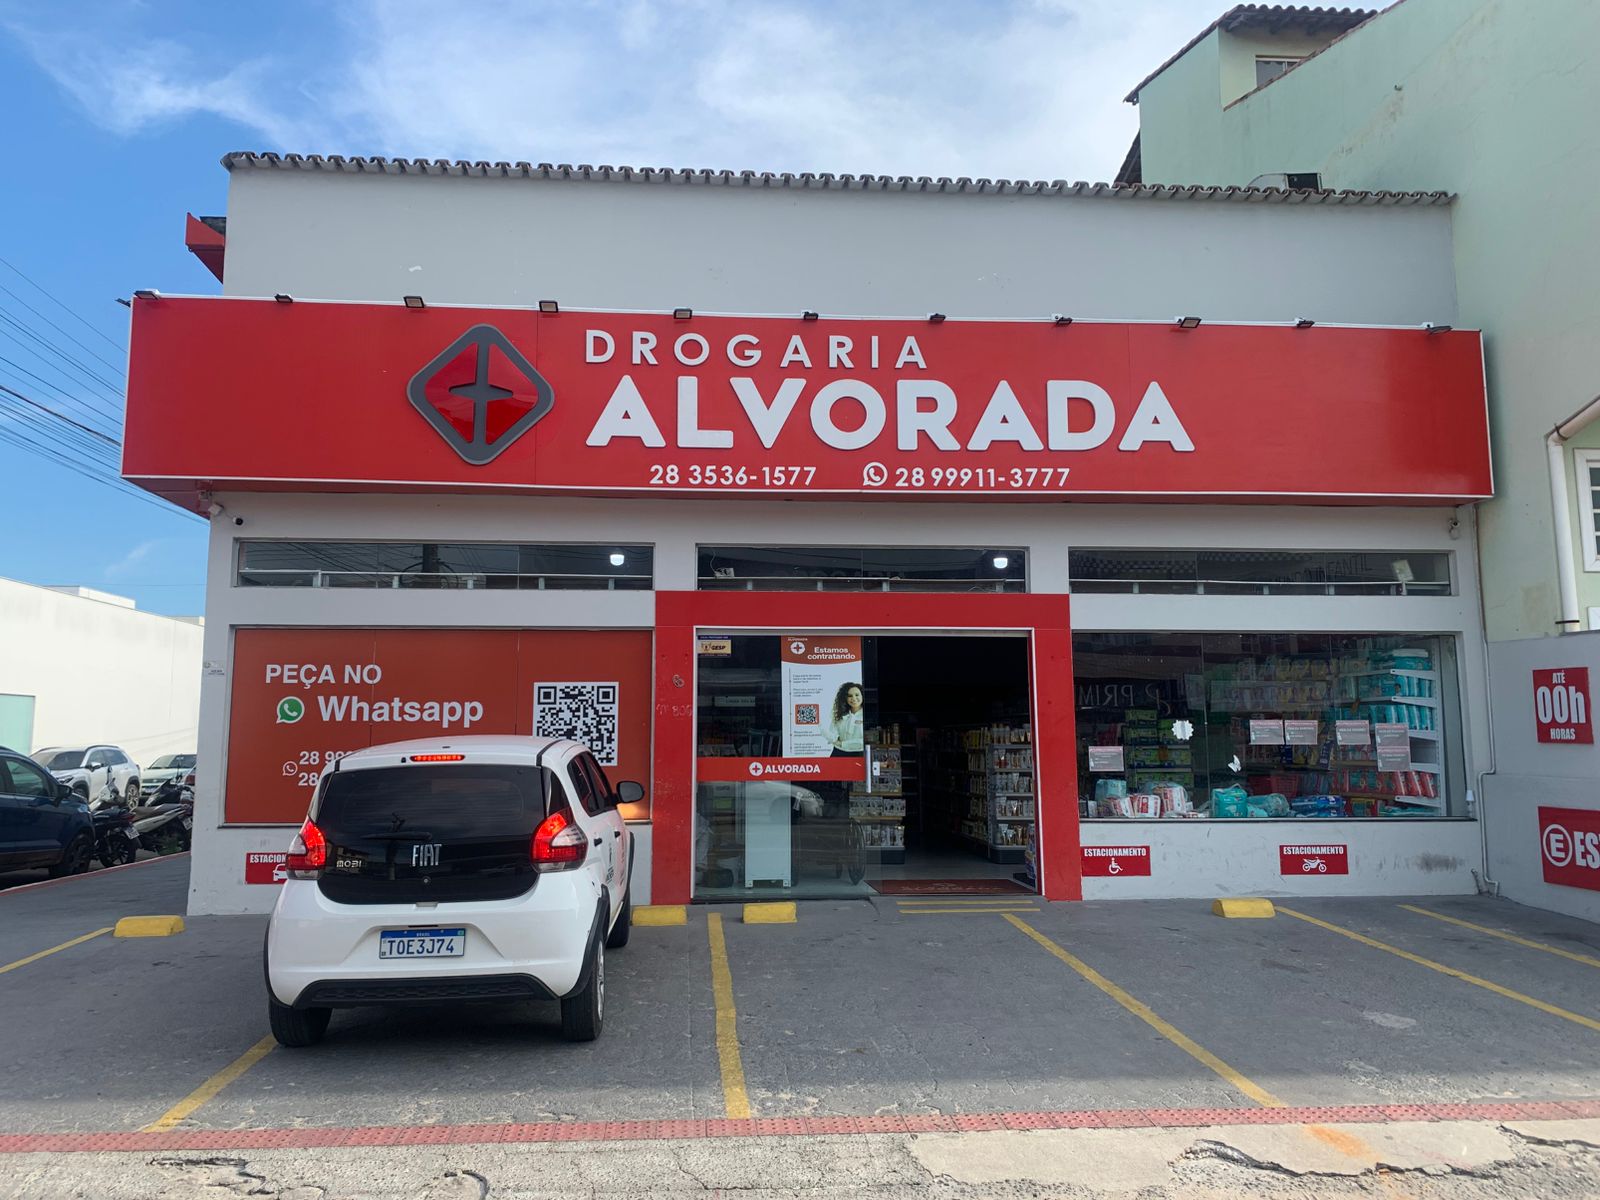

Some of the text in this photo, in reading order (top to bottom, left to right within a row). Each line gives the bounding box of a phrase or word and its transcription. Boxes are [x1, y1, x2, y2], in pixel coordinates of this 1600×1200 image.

[585, 329, 927, 369] DROGARIA
[586, 374, 1195, 451] ALVORADA
[649, 464, 817, 486] 28 3536-1577
[895, 467, 1070, 487] 28 99911-3777
[814, 646, 849, 654] Estamos
[265, 664, 382, 689] PEÇA NO
[1552, 670, 1566, 684] ATÉ
[317, 695, 484, 729] Whatsapp
[1536, 686, 1586, 724] 00h
[1550, 728, 1576, 740] HORAS
[299, 751, 353, 765] 28 99
[764, 764, 821, 774] ALVORADA
[298, 772, 319, 786] 28
[412, 844, 442, 867] FIAT
[1084, 848, 1146, 857] ESTACIONAMENTO
[1283, 846, 1344, 856] ESTACIONAMENTO
[1573, 831, 1600, 869] ES
[388, 939, 454, 955] TOE3J74
